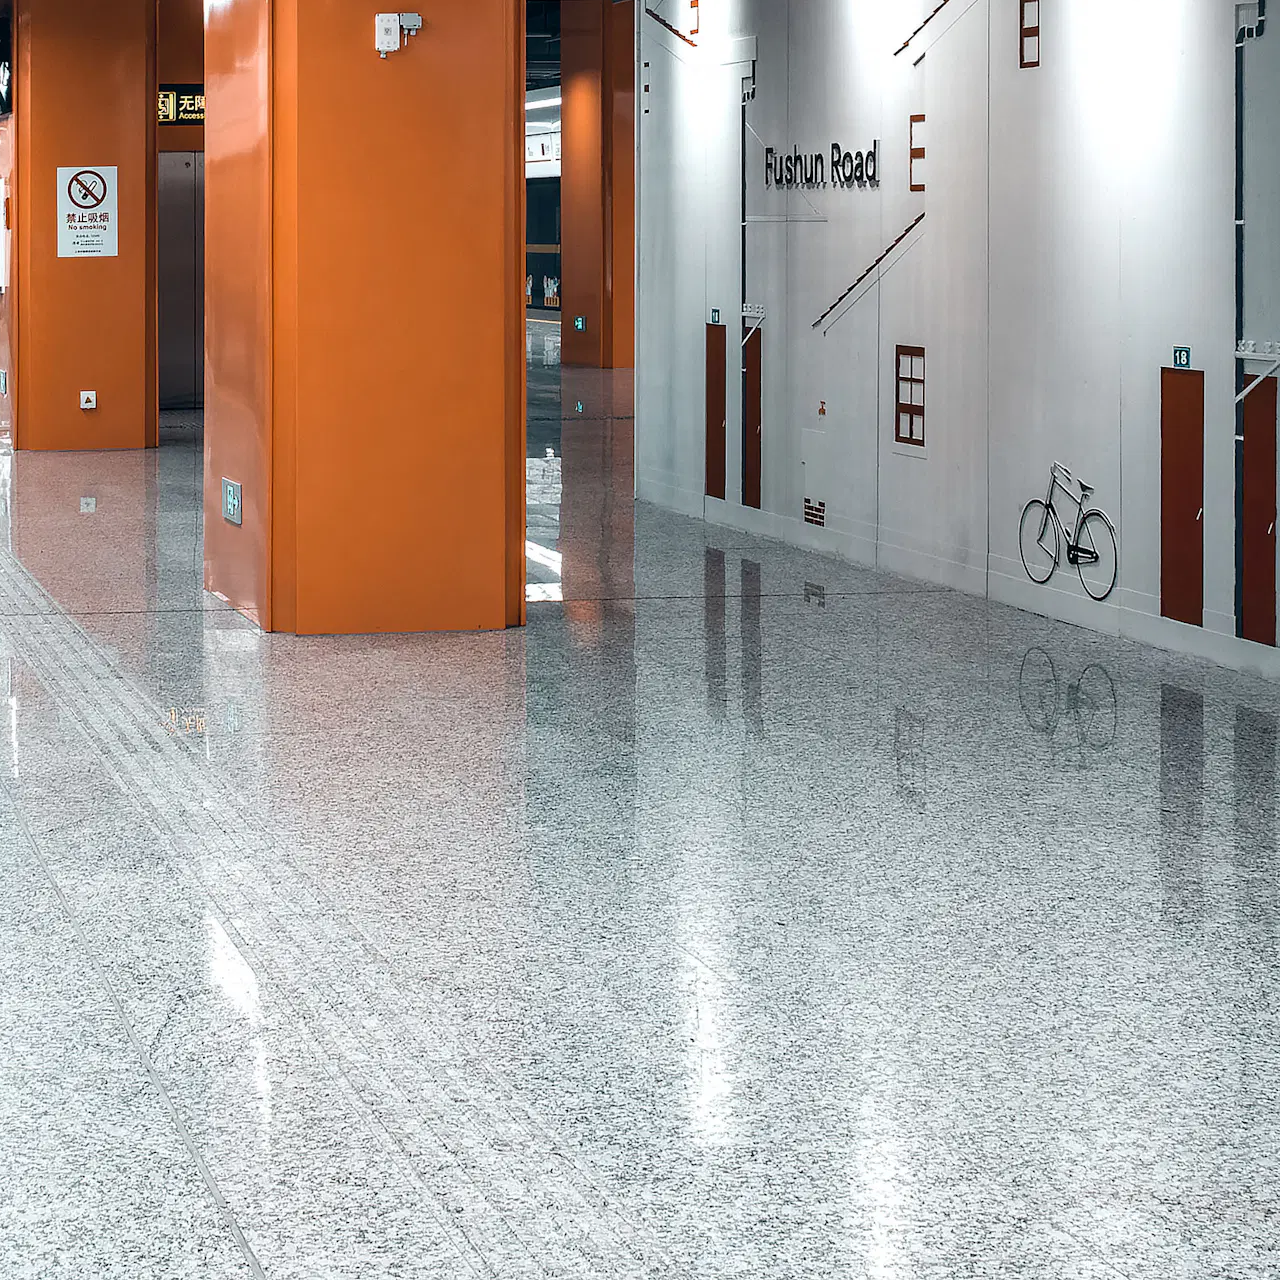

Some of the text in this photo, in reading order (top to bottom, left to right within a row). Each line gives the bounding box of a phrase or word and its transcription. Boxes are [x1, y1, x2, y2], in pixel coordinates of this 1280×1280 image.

[765, 139, 880, 186] Fushun Road
[66, 212, 110, 224] 禁止吸烟
[79, 224, 107, 232] smoking
[1174, 350, 1188, 365] 18
